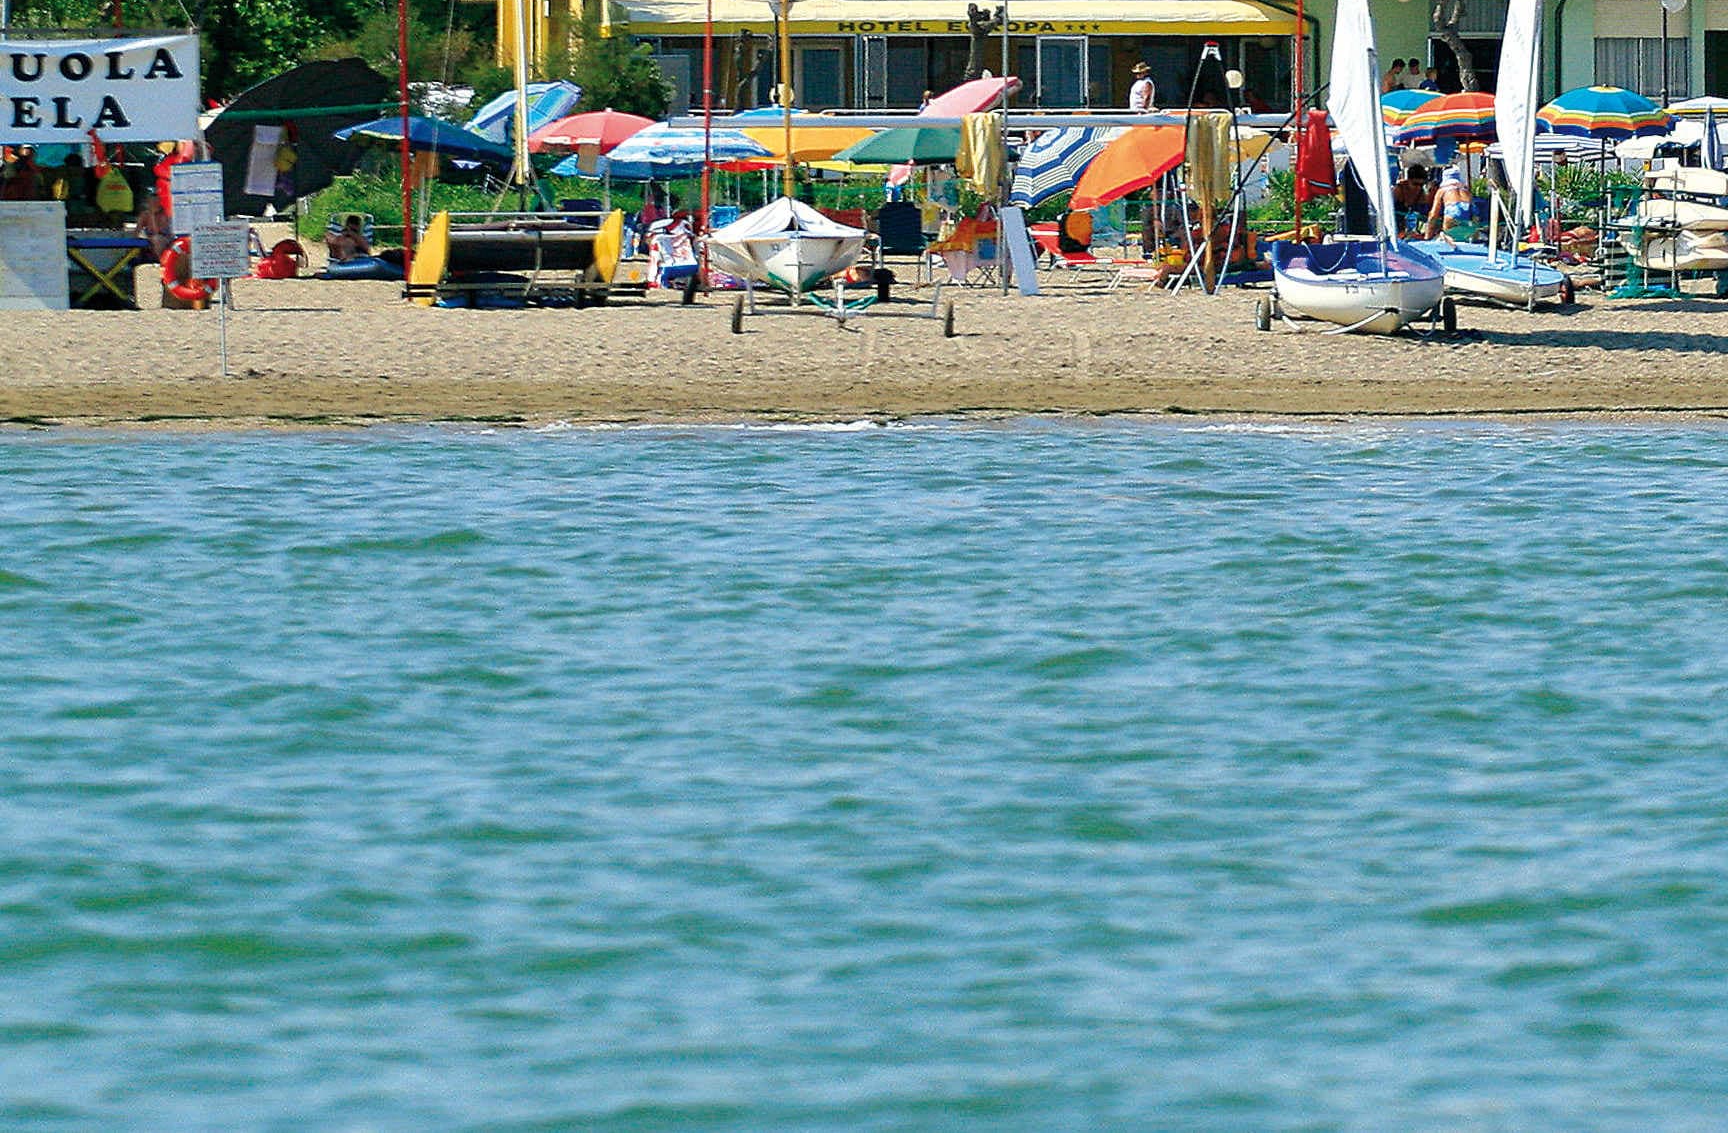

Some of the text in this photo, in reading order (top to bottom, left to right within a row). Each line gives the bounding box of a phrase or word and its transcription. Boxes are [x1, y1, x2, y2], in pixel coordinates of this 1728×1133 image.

[838, 21, 1055, 32] HOTEL EOPA
[10, 48, 184, 82] UOLA
